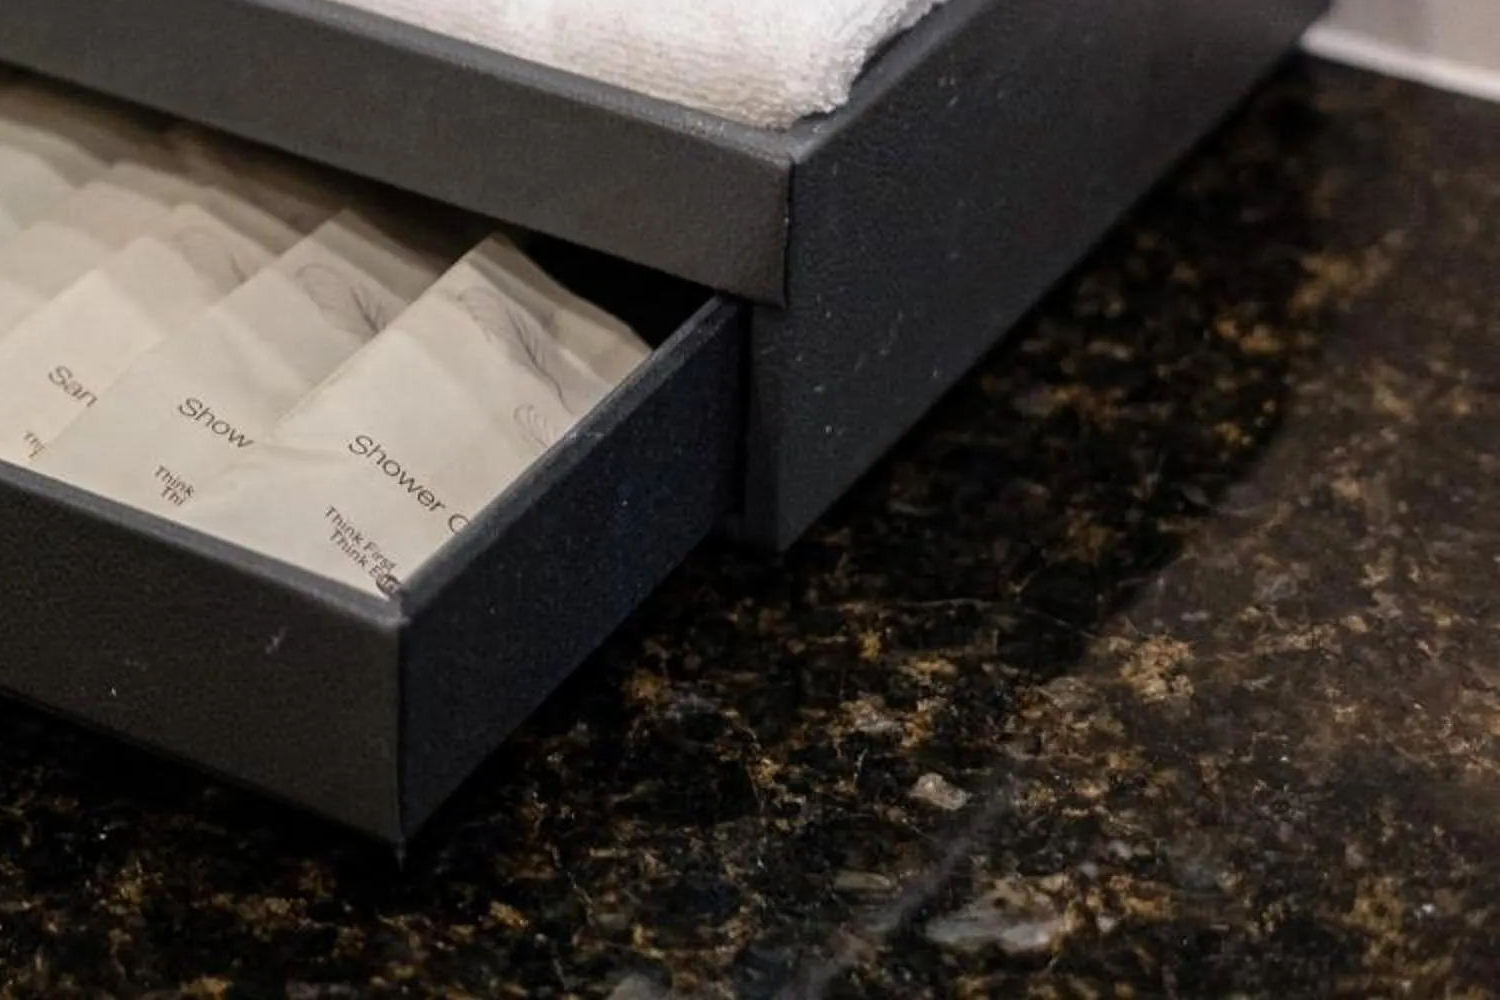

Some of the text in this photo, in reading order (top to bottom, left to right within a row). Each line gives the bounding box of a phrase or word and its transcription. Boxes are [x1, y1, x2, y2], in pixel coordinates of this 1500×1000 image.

[47, 365, 98, 408] San
[177, 396, 254, 449] Show
[348, 434, 445, 512] Shower
[323, 506, 365, 545] Think
[328, 528, 368, 568] Think
